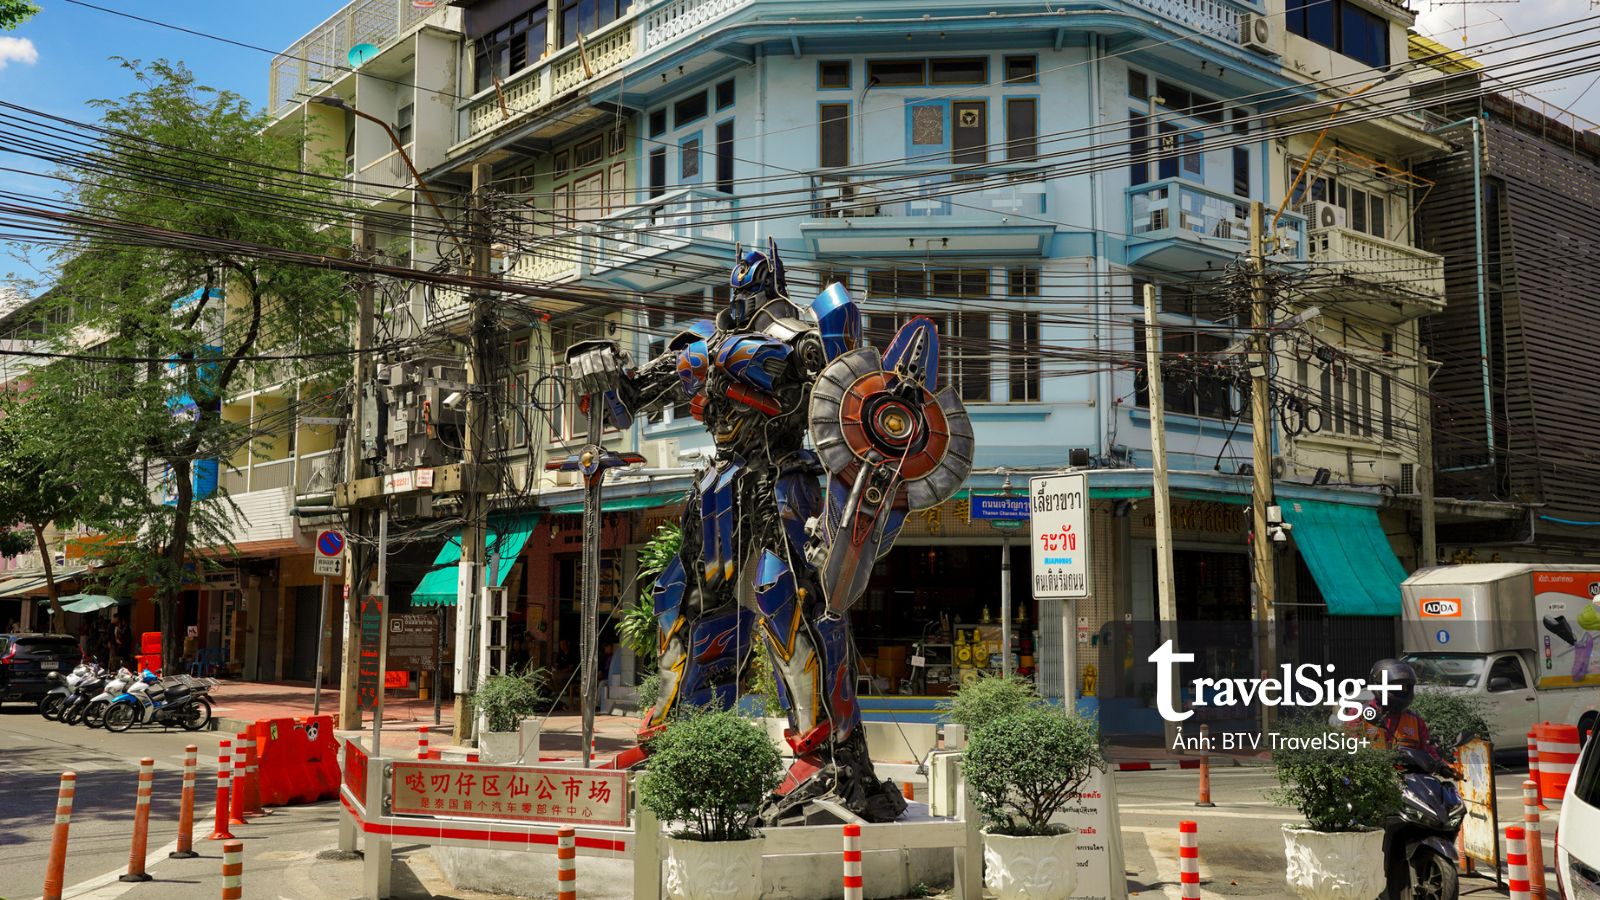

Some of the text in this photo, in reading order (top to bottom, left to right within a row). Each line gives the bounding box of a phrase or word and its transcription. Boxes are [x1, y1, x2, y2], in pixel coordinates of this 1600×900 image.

[1033, 481, 1081, 513] เลี้ยวขวา
[1040, 524, 1076, 551] ระวัง
[1035, 568, 1084, 592] คนเดินริมถนน
[1426, 602, 1454, 613] ADDA
[405, 771, 612, 804] 哒叨仔区仙公市场
[420, 797, 593, 818] 是泰国首个汽车零部件中心
